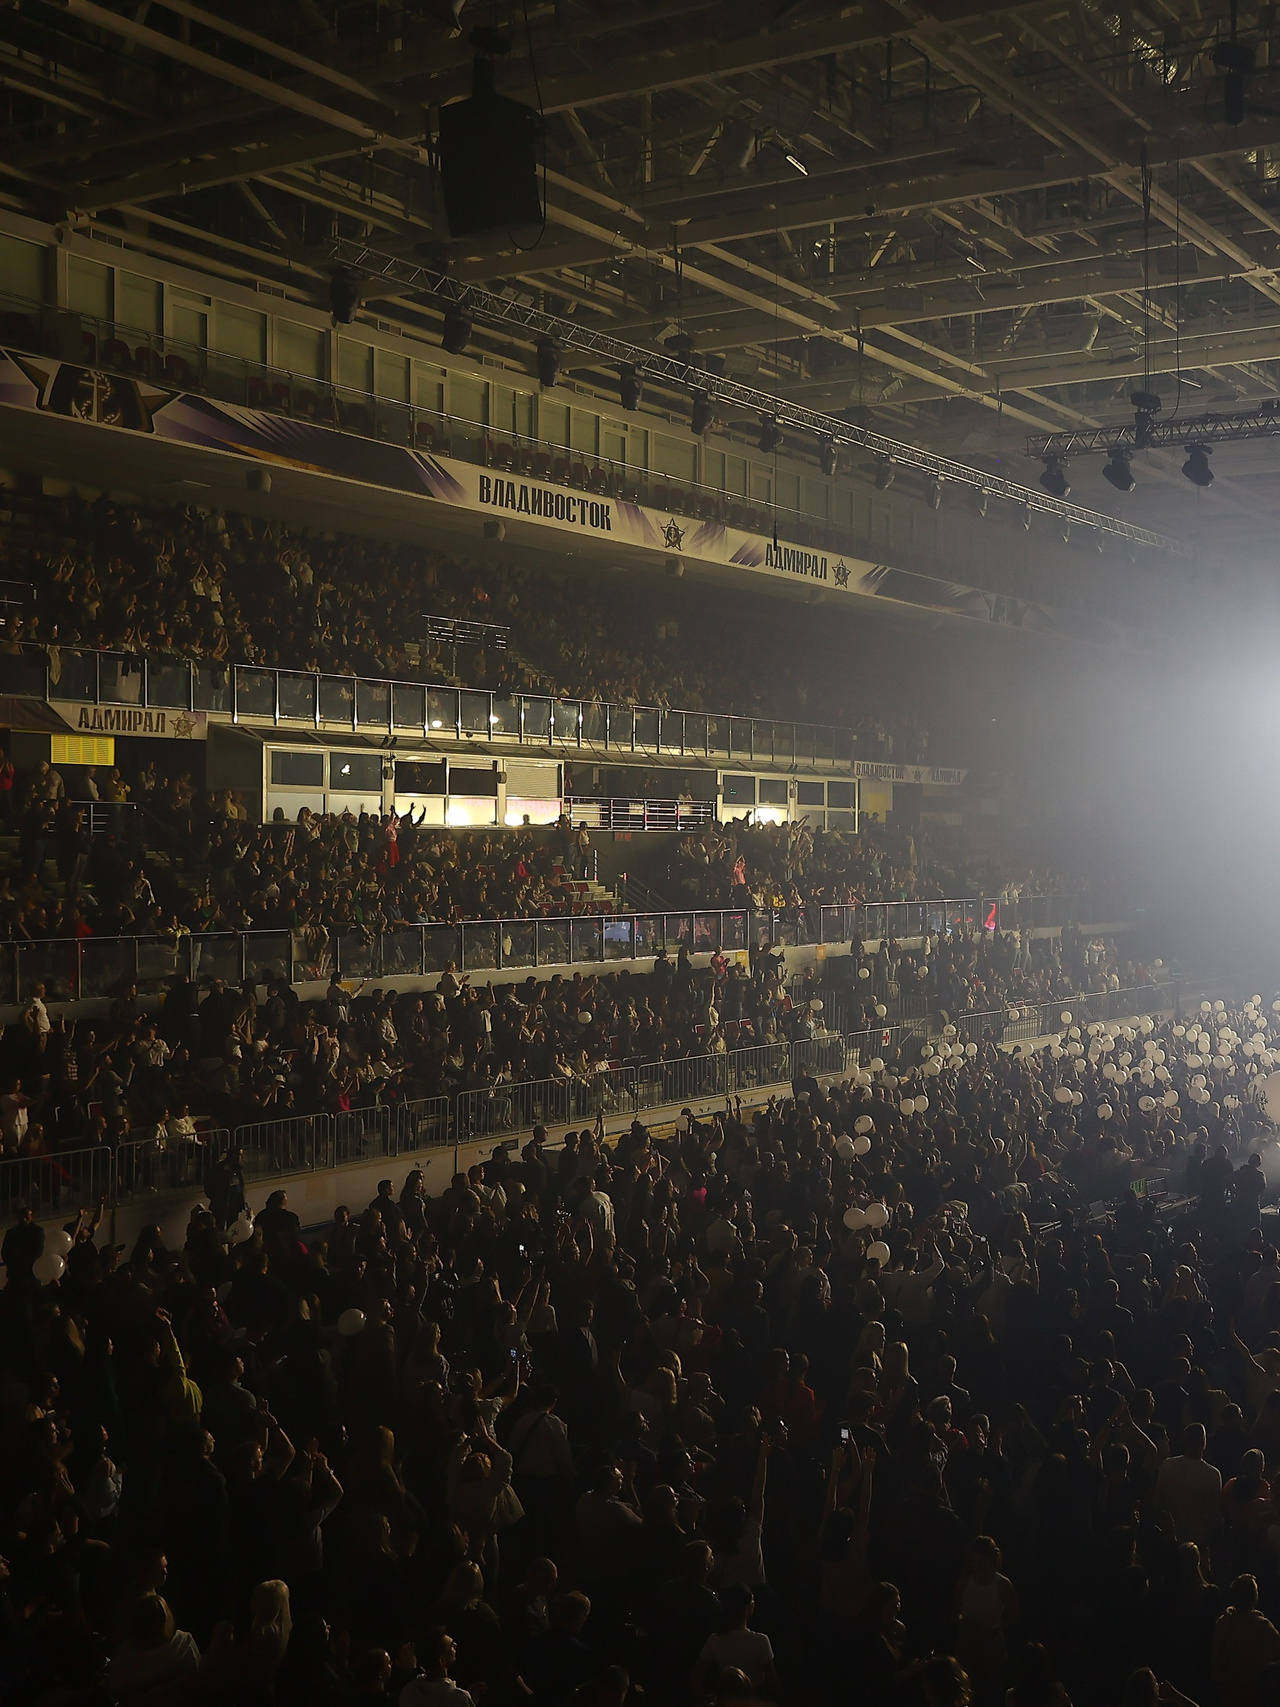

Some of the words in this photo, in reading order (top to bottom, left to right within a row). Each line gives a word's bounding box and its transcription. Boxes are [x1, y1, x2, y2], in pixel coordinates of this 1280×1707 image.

[479, 474, 612, 531] ВЛАДИВОСТОК
[765, 542, 828, 580] АДМИРАЛ
[78, 707, 166, 733] АДМИРАЛ
